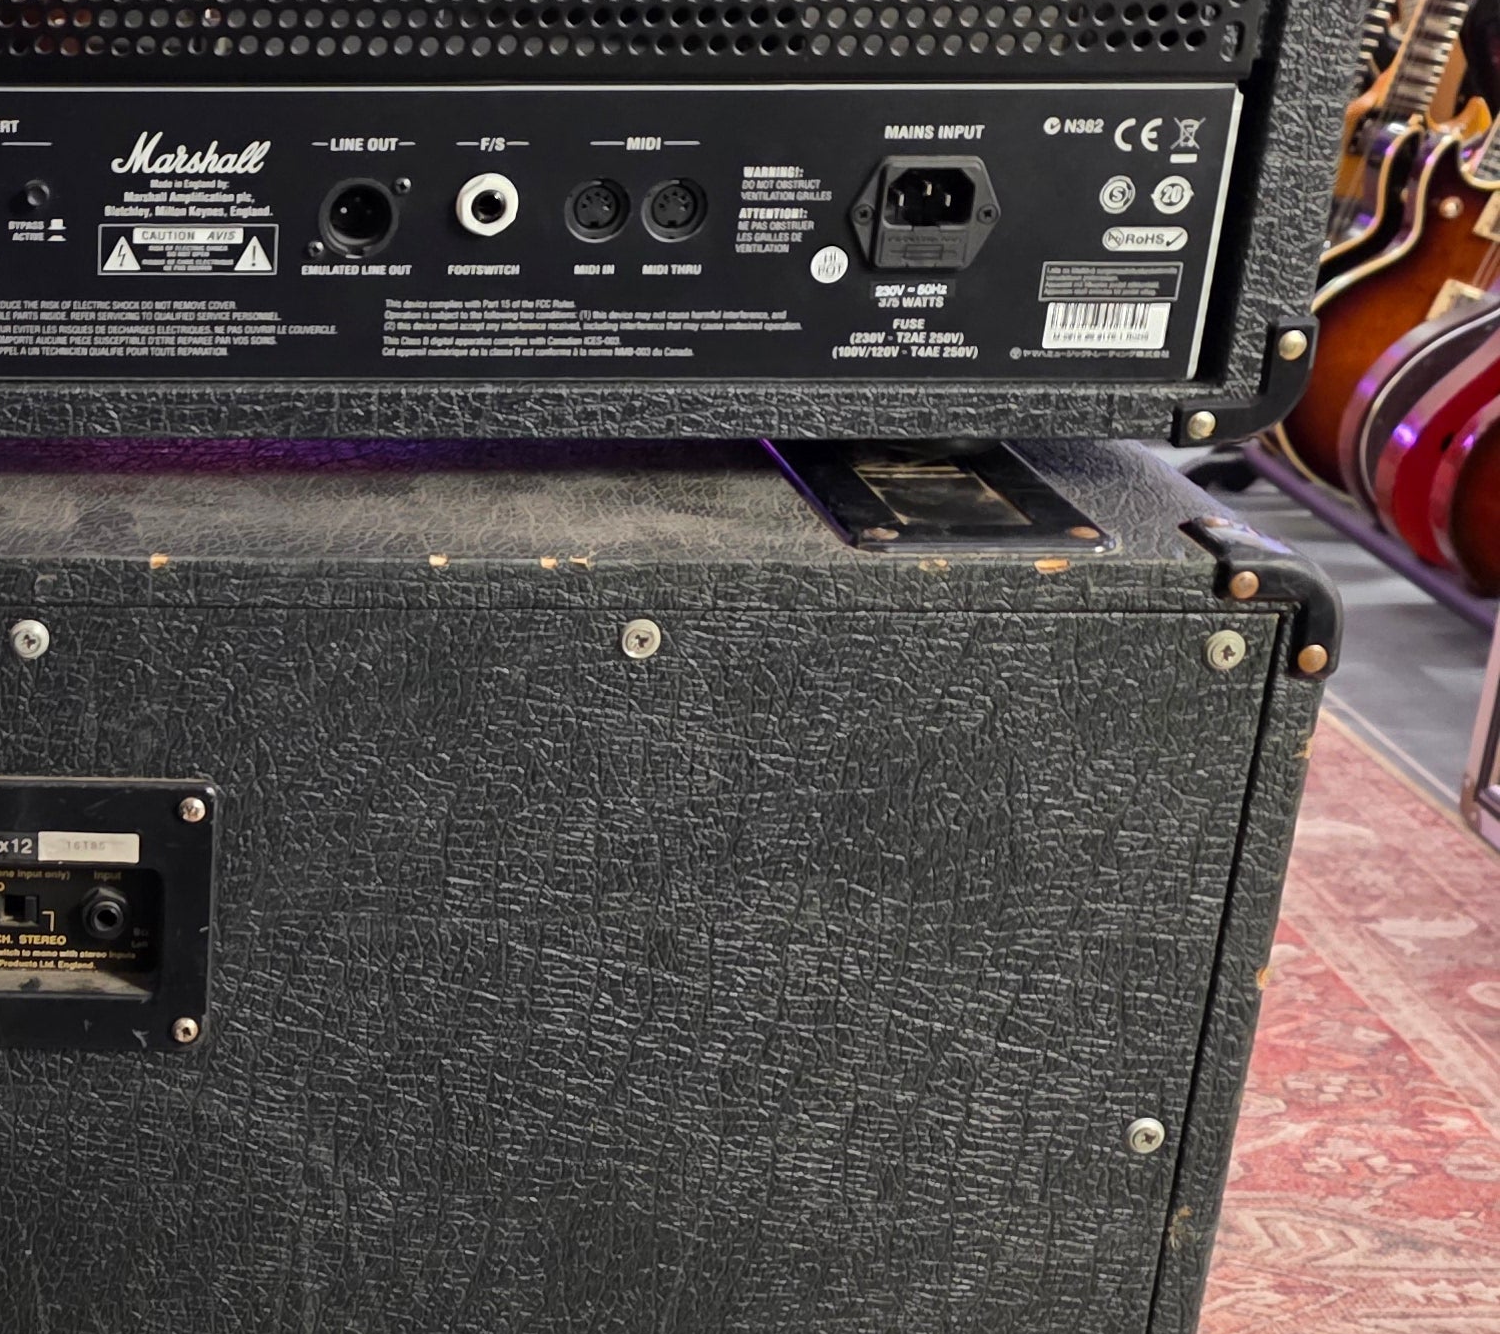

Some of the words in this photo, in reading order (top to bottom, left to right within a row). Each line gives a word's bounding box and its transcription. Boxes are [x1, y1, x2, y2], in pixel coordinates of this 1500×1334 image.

[884, 125, 935, 139] MAINS
[938, 125, 985, 139] INPUT
[330, 138, 364, 151] LINE
[367, 138, 400, 151] OUT
[480, 138, 505, 151] F/S
[626, 137, 661, 150] MIDI
[111, 132, 271, 173] Marshall
[744, 166, 804, 178] WARNING!:
[184, 179, 216, 189] England
[742, 180, 755, 189] DO
[757, 180, 774, 189] NOT
[776, 179, 821, 189] OBSTRUCT
[124, 192, 167, 202] Marshall
[741, 191, 794, 200] VENTILATION
[796, 191, 832, 201] GRILLES
[1161, 184, 1185, 204] 20
[230, 206, 273, 218] England.
[739, 208, 808, 219] ATTENTION!:
[738, 221, 749, 230] NE
[751, 221, 767, 230] PAS
[770, 221, 814, 230] OBSTRUER
[142, 231, 195, 240] CAUTION
[207, 231, 236, 240] AVIS
[736, 233, 752, 242] LES
[754, 233, 789, 242] GRILLES
[791, 232, 802, 242] DE
[1124, 234, 1164, 244] RoHS
[735, 244, 789, 253] VENTILATION
[302, 265, 359, 275] EMULATED
[362, 265, 386, 275] LINE
[389, 265, 412, 275] OUT
[448, 265, 520, 275] FOOTSWITCH
[574, 265, 600, 274] MIDI
[602, 265, 614, 274] IN
[642, 265, 668, 274] MIDI
[671, 265, 702, 274] THRU
[875, 285, 905, 297] 230V
[902, 296, 944, 307] WATTS
[893, 319, 925, 329] FUSE
[850, 332, 885, 344] (230V
[896, 332, 926, 343] T2AE
[929, 332, 964, 345] 250V)
[832, 346, 899, 359] (100V/120V
[910, 346, 940, 357] T4AE
[943, 346, 978, 359] 250V)
[19, 935, 66, 945] STEREO
[58, 961, 96, 970] England.
